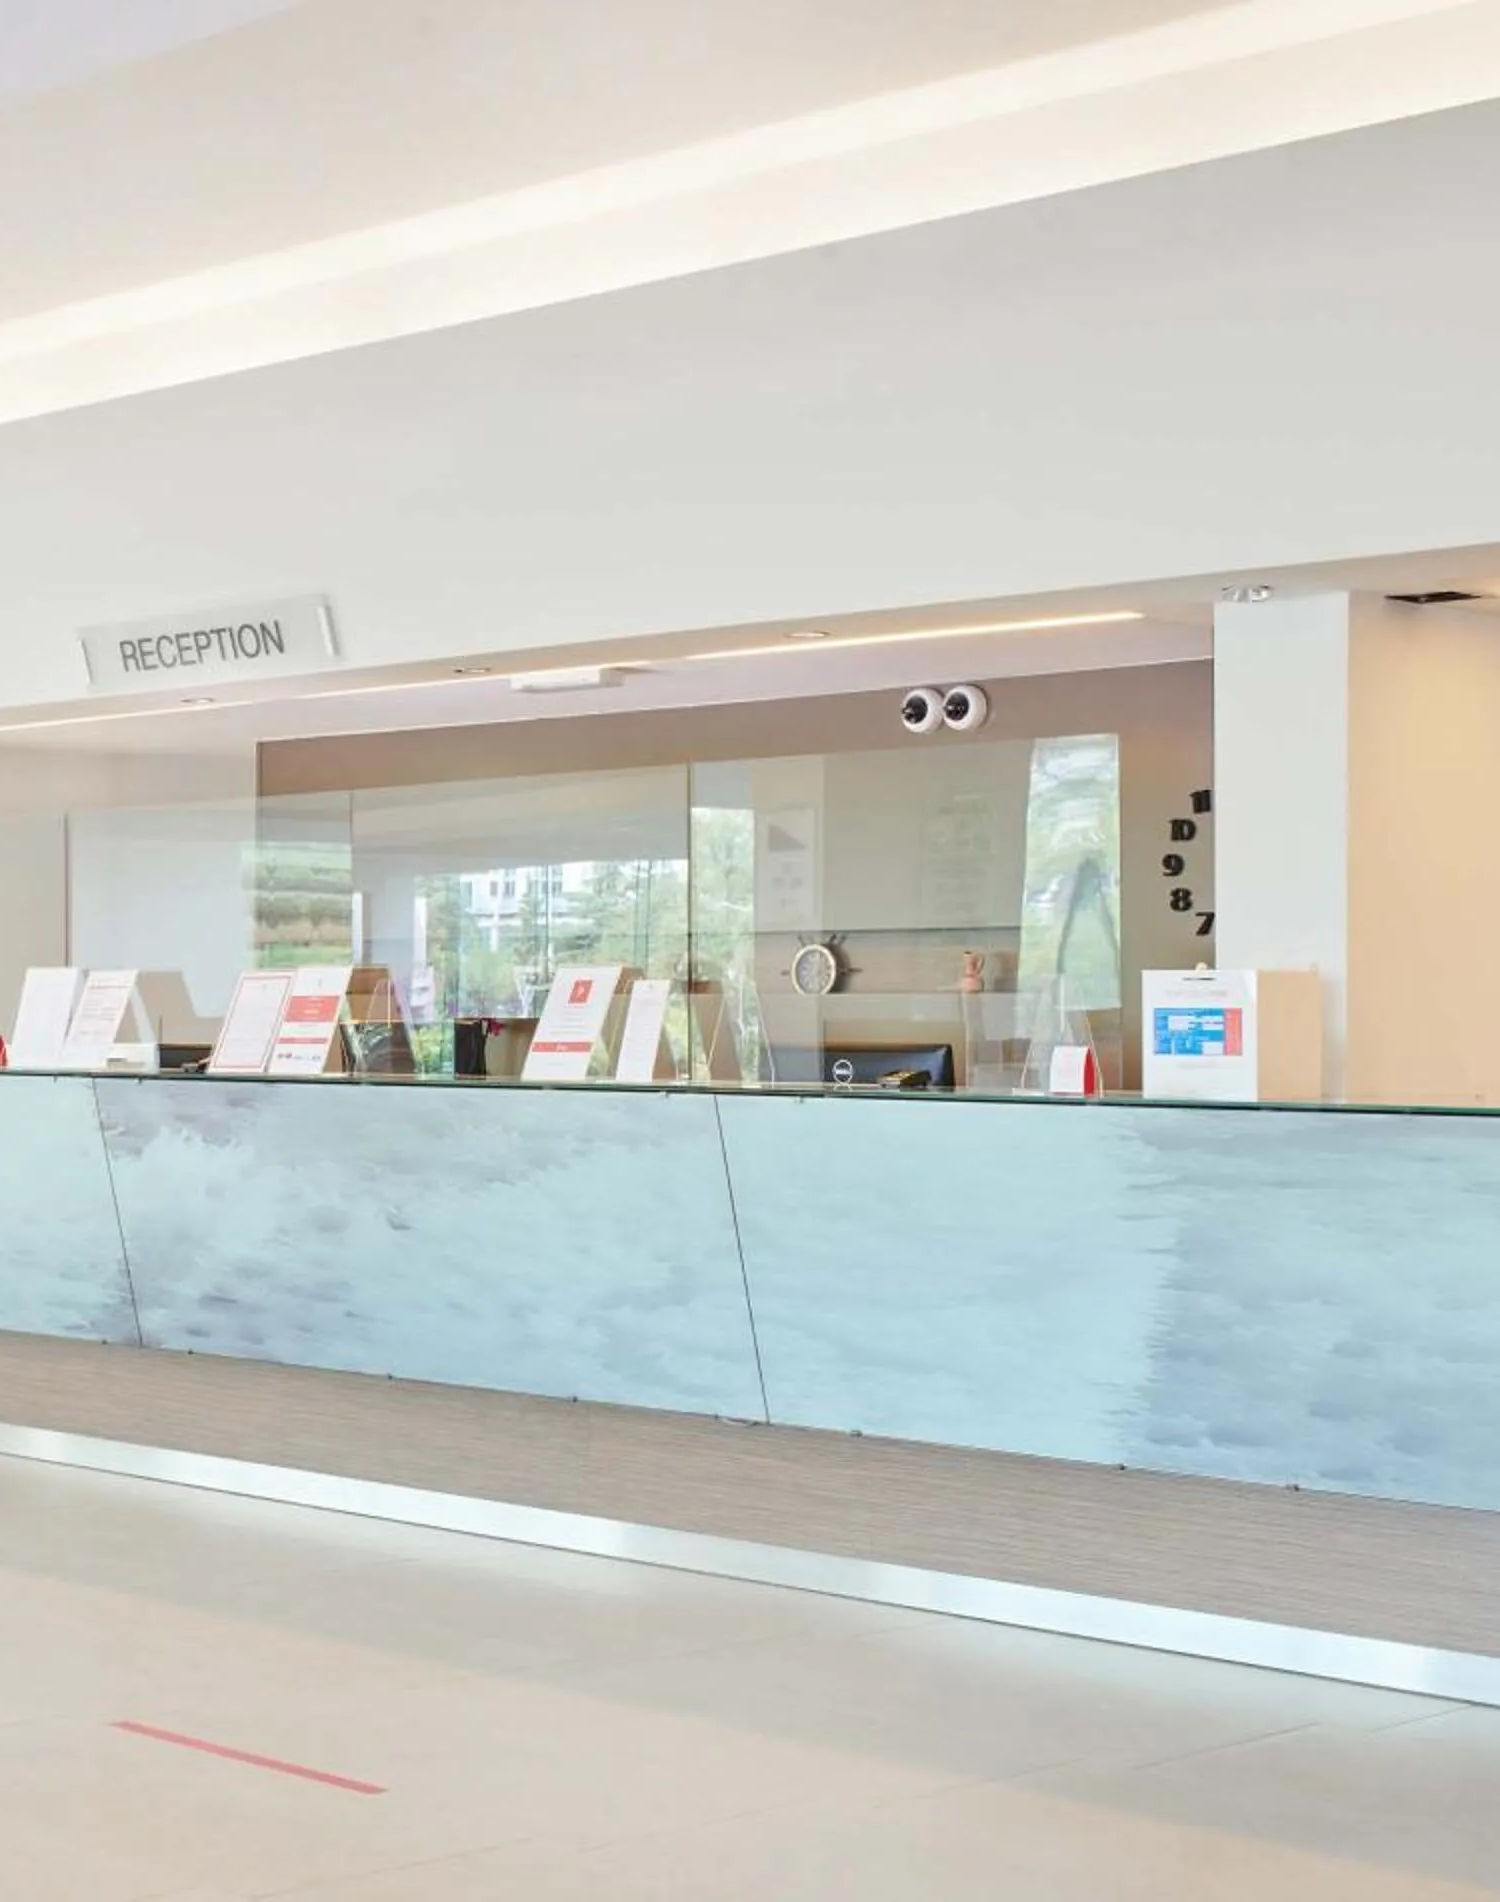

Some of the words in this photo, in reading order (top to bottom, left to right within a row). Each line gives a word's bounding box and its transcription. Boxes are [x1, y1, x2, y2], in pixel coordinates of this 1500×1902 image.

[119, 619, 285, 673] RECEPTION
[1162, 853, 1185, 877] 9
[1169, 887, 1193, 912] 8
[1195, 911, 1215, 936] 7
